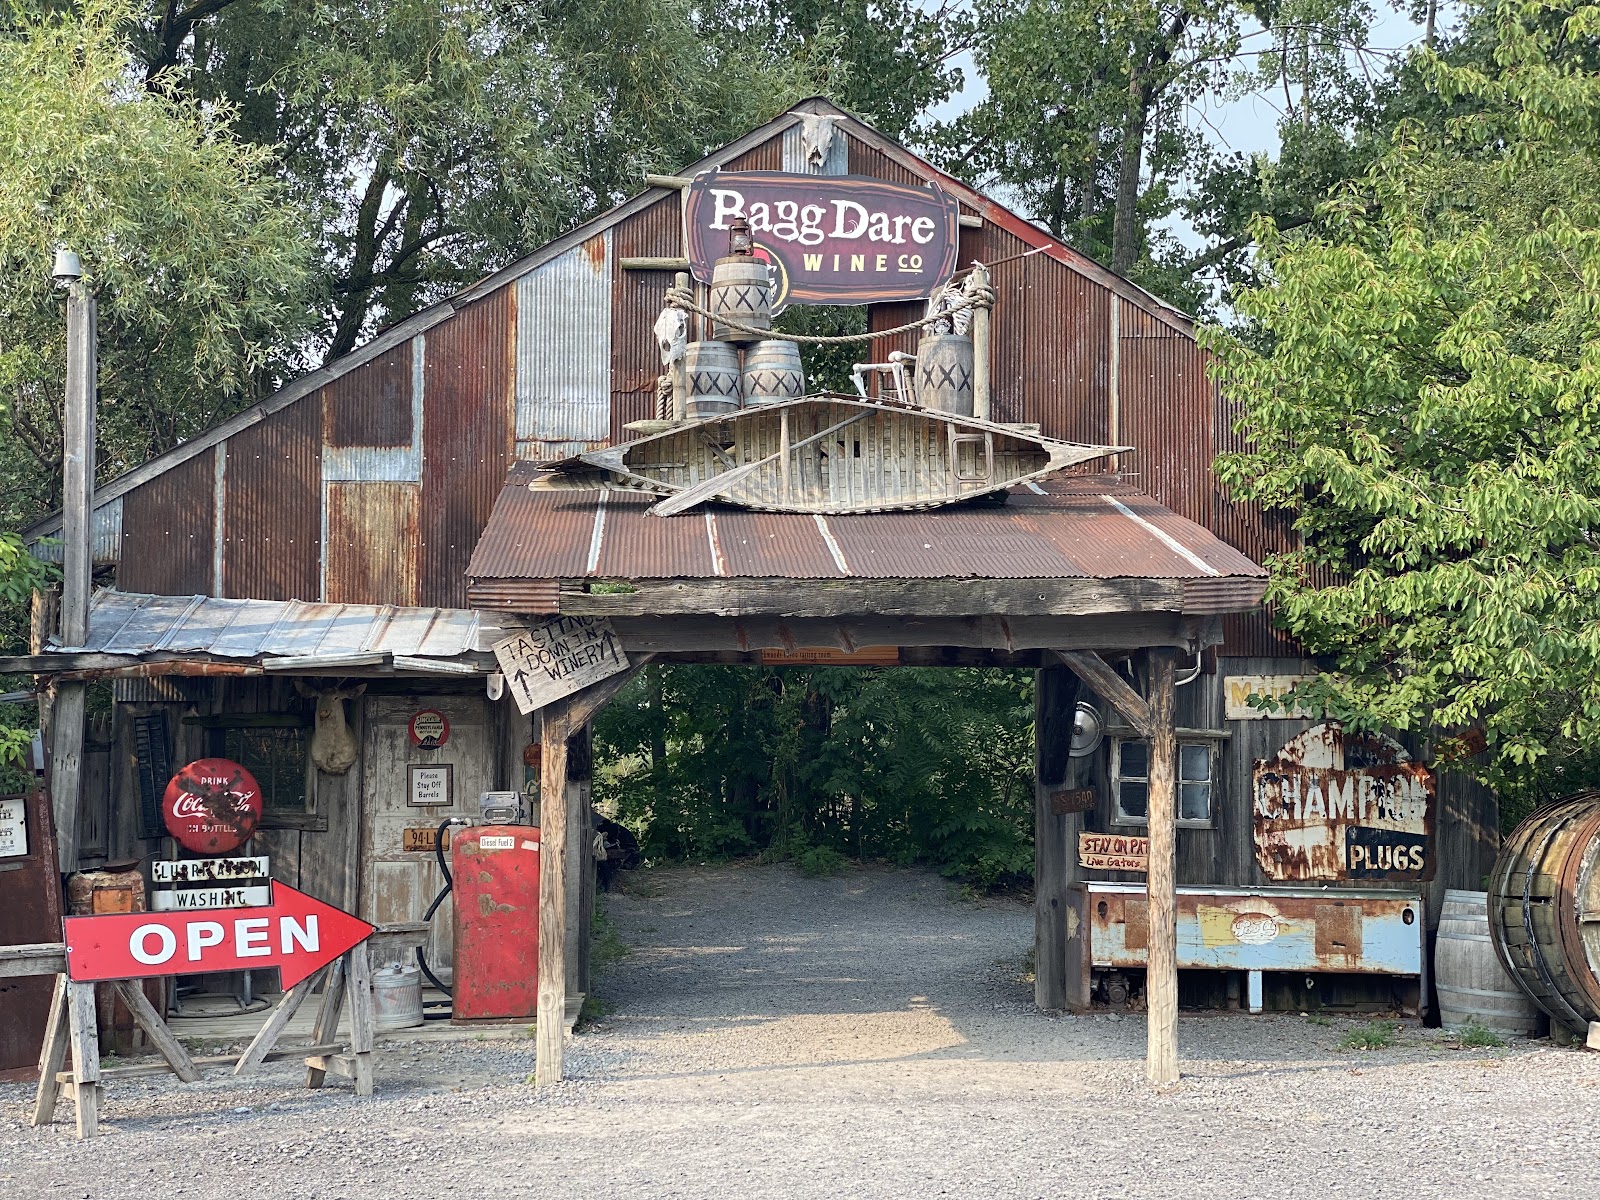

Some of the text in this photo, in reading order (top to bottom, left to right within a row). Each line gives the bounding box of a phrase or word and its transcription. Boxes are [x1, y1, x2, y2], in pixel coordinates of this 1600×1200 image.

[709, 189, 936, 246] Bagg Dare
[803, 253, 923, 272] WINE CO
[526, 638, 571, 671] DOWN
[543, 641, 606, 681] WINERY
[200, 777, 229, 785] DRINK
[420, 772, 438, 780] Please
[417, 781, 442, 791] Stay Off
[418, 791, 439, 799] Barrels
[481, 838, 513, 847] Diesel Fuel 2
[1084, 837, 1111, 853] STAY
[1130, 838, 1149, 855] PAT
[1086, 856, 1104, 867] Live
[1350, 845, 1425, 871] PLUGS
[177, 890, 247, 907] WASHING
[129, 914, 321, 965] OPEN
